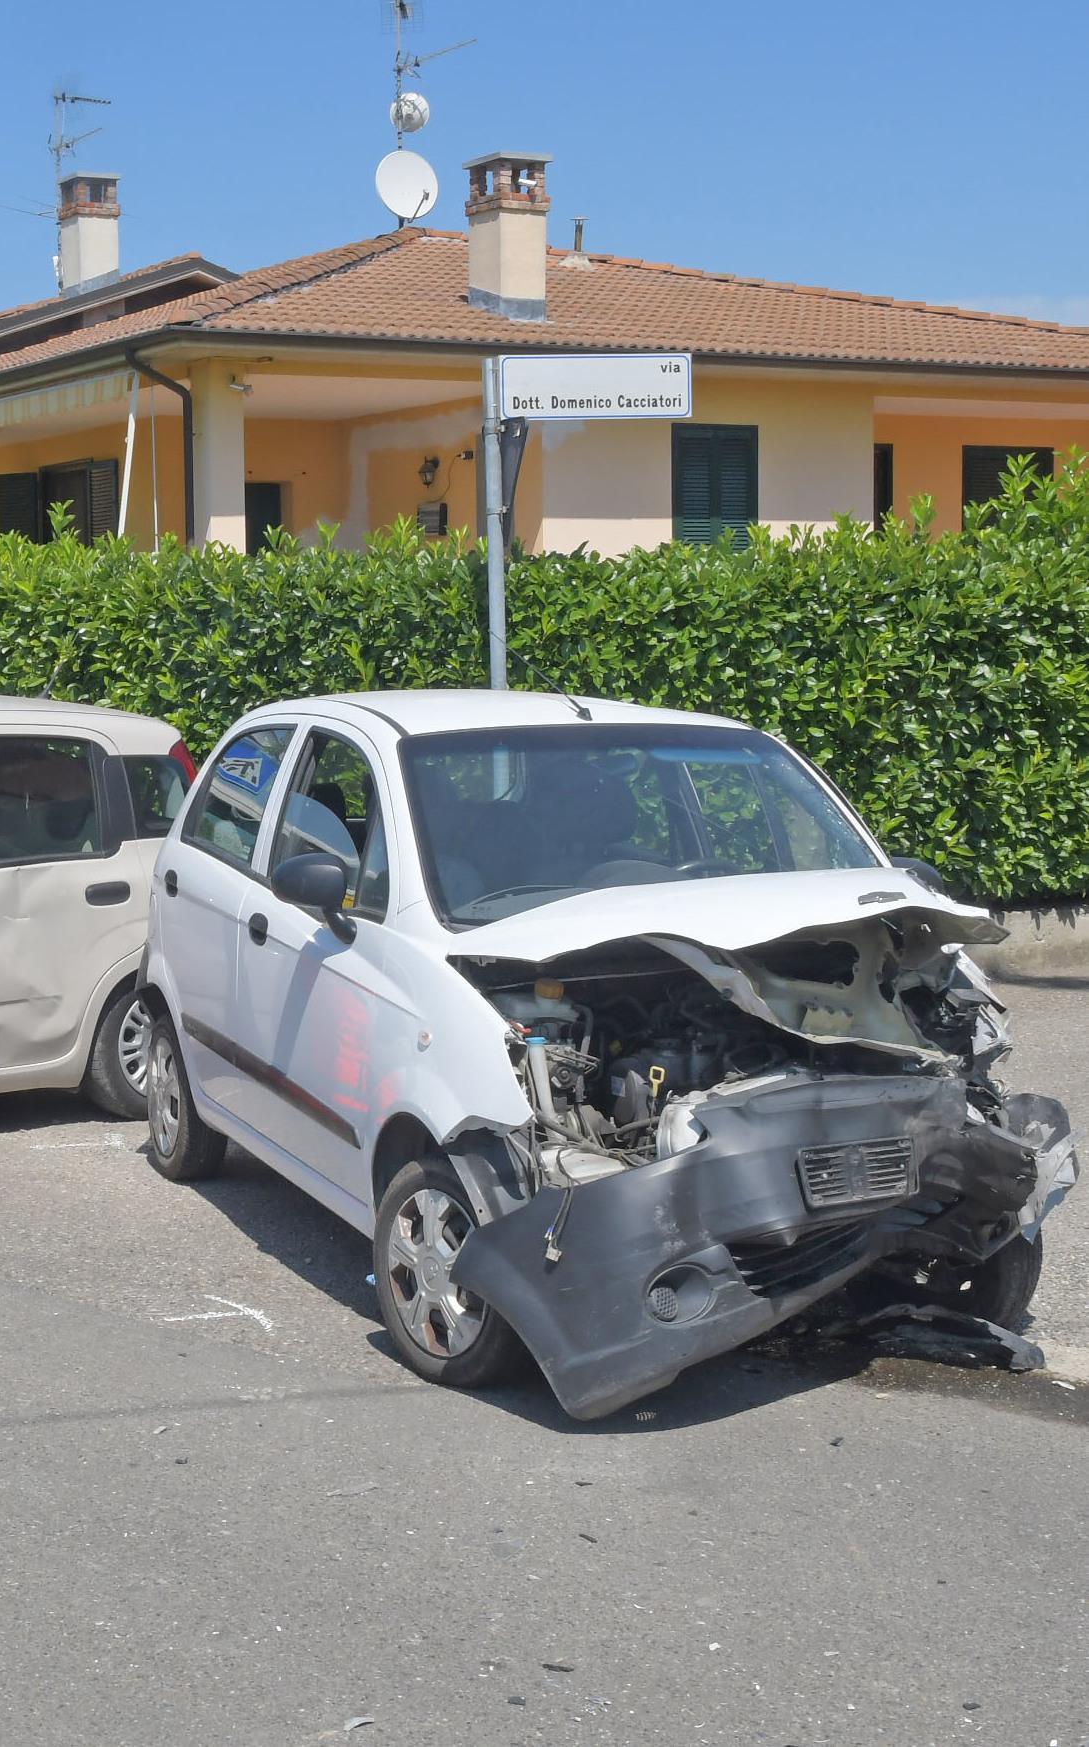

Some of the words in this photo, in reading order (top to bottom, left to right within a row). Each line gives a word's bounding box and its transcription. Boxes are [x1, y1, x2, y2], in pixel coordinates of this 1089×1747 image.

[660, 361, 681, 373] via
[512, 396, 544, 411] Dott.
[551, 395, 612, 409] Domenico
[617, 393, 682, 409] Cacciatori
